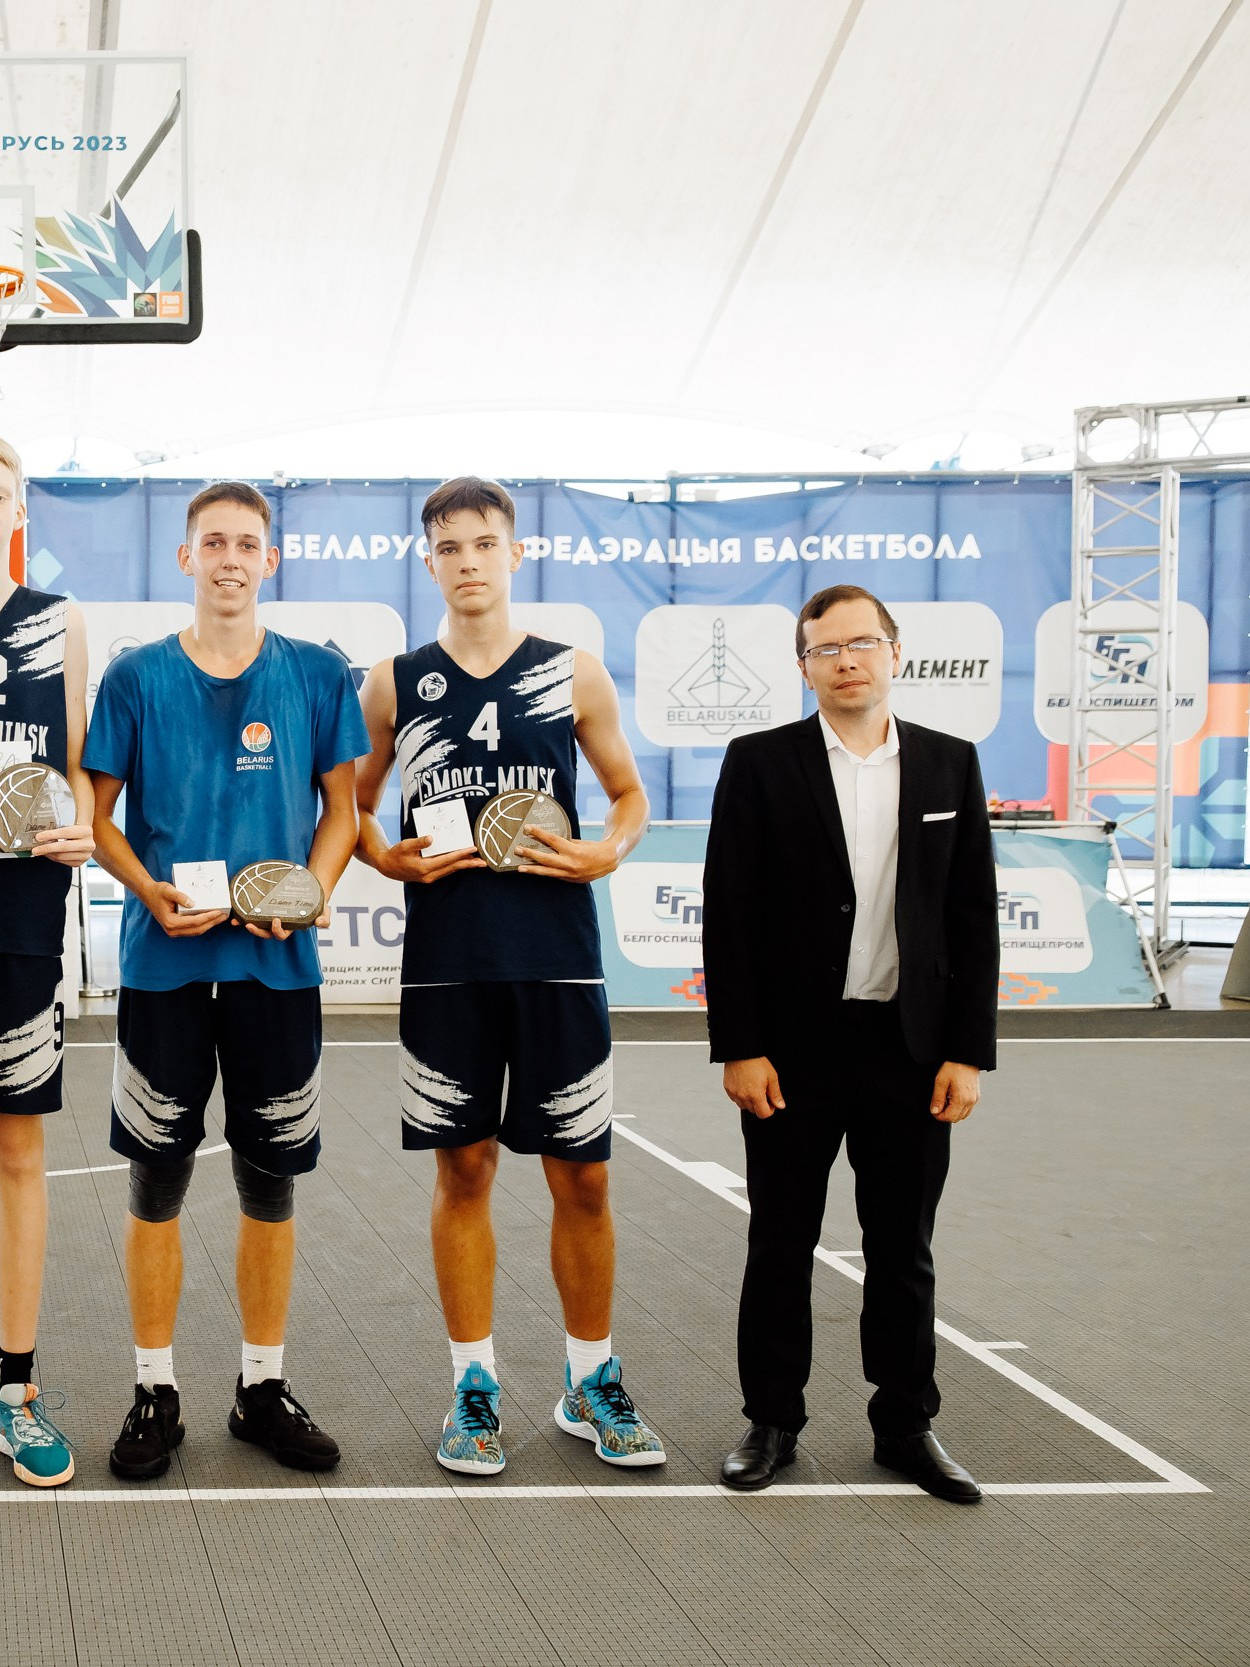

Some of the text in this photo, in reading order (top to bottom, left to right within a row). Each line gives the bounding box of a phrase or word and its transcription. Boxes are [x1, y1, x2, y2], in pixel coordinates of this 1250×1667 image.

[73, 135, 128, 152] 2023
[283, 533, 982, 567] БЕЛАРУС ФЕДЭРАЦЫЯ БАСКЕТБОЛА
[892, 659, 989, 679] ЛЕМЕНТ
[667, 709, 772, 722] BELARUSKALI
[467, 701, 501, 751] 4
[236, 756, 274, 765] BELARUS
[236, 764, 273, 772] BASKETBALL
[623, 935, 702, 944] БЕЛГОСПИЩ
[1001, 941, 1085, 950] СПИЩЕПРОМ
[371, 977, 396, 986] СНГ
